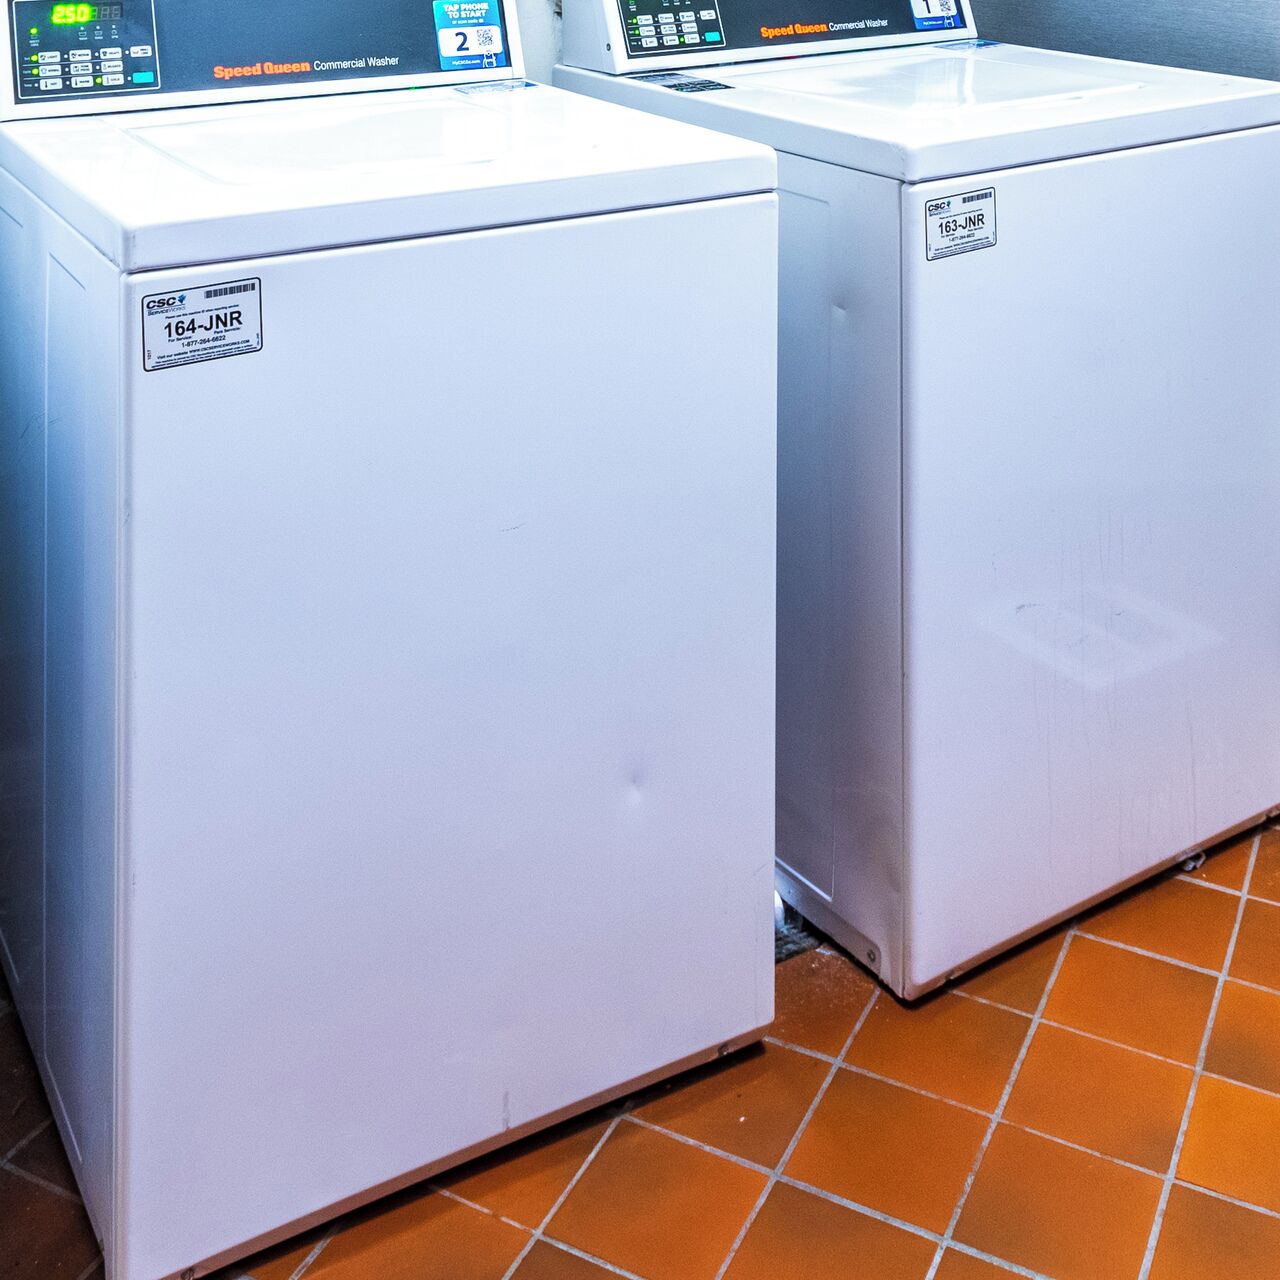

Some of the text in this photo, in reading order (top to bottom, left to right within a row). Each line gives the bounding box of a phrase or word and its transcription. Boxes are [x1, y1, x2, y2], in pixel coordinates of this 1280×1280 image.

[443, 2, 489, 12] TAP PHONE
[447, 10, 487, 19] TO START
[760, 18, 889, 39] Speed Queen Commercial Washer
[455, 31, 470, 52] 2
[214, 55, 400, 80] Speed Queen Commercial Washer
[928, 201, 946, 211] CSC
[938, 213, 985, 235] 163-JNR
[146, 297, 177, 309] CSC
[164, 310, 243, 338] 164-JNR
